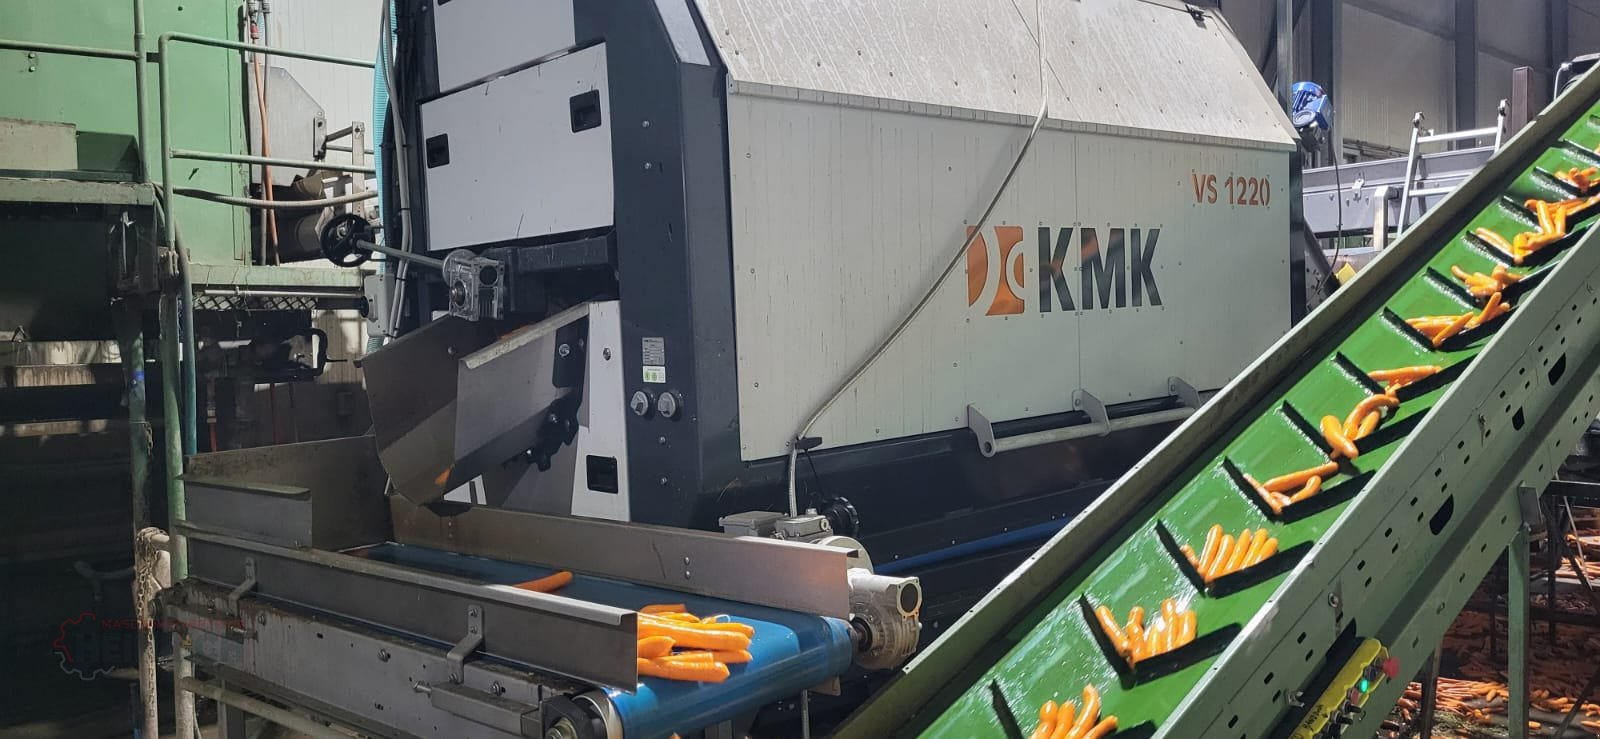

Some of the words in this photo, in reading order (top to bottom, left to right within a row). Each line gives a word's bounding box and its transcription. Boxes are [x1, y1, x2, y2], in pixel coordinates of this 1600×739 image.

[1194, 174, 1218, 205] VS
[1225, 176, 1271, 206] 1220
[1038, 227, 1162, 312] KMK
